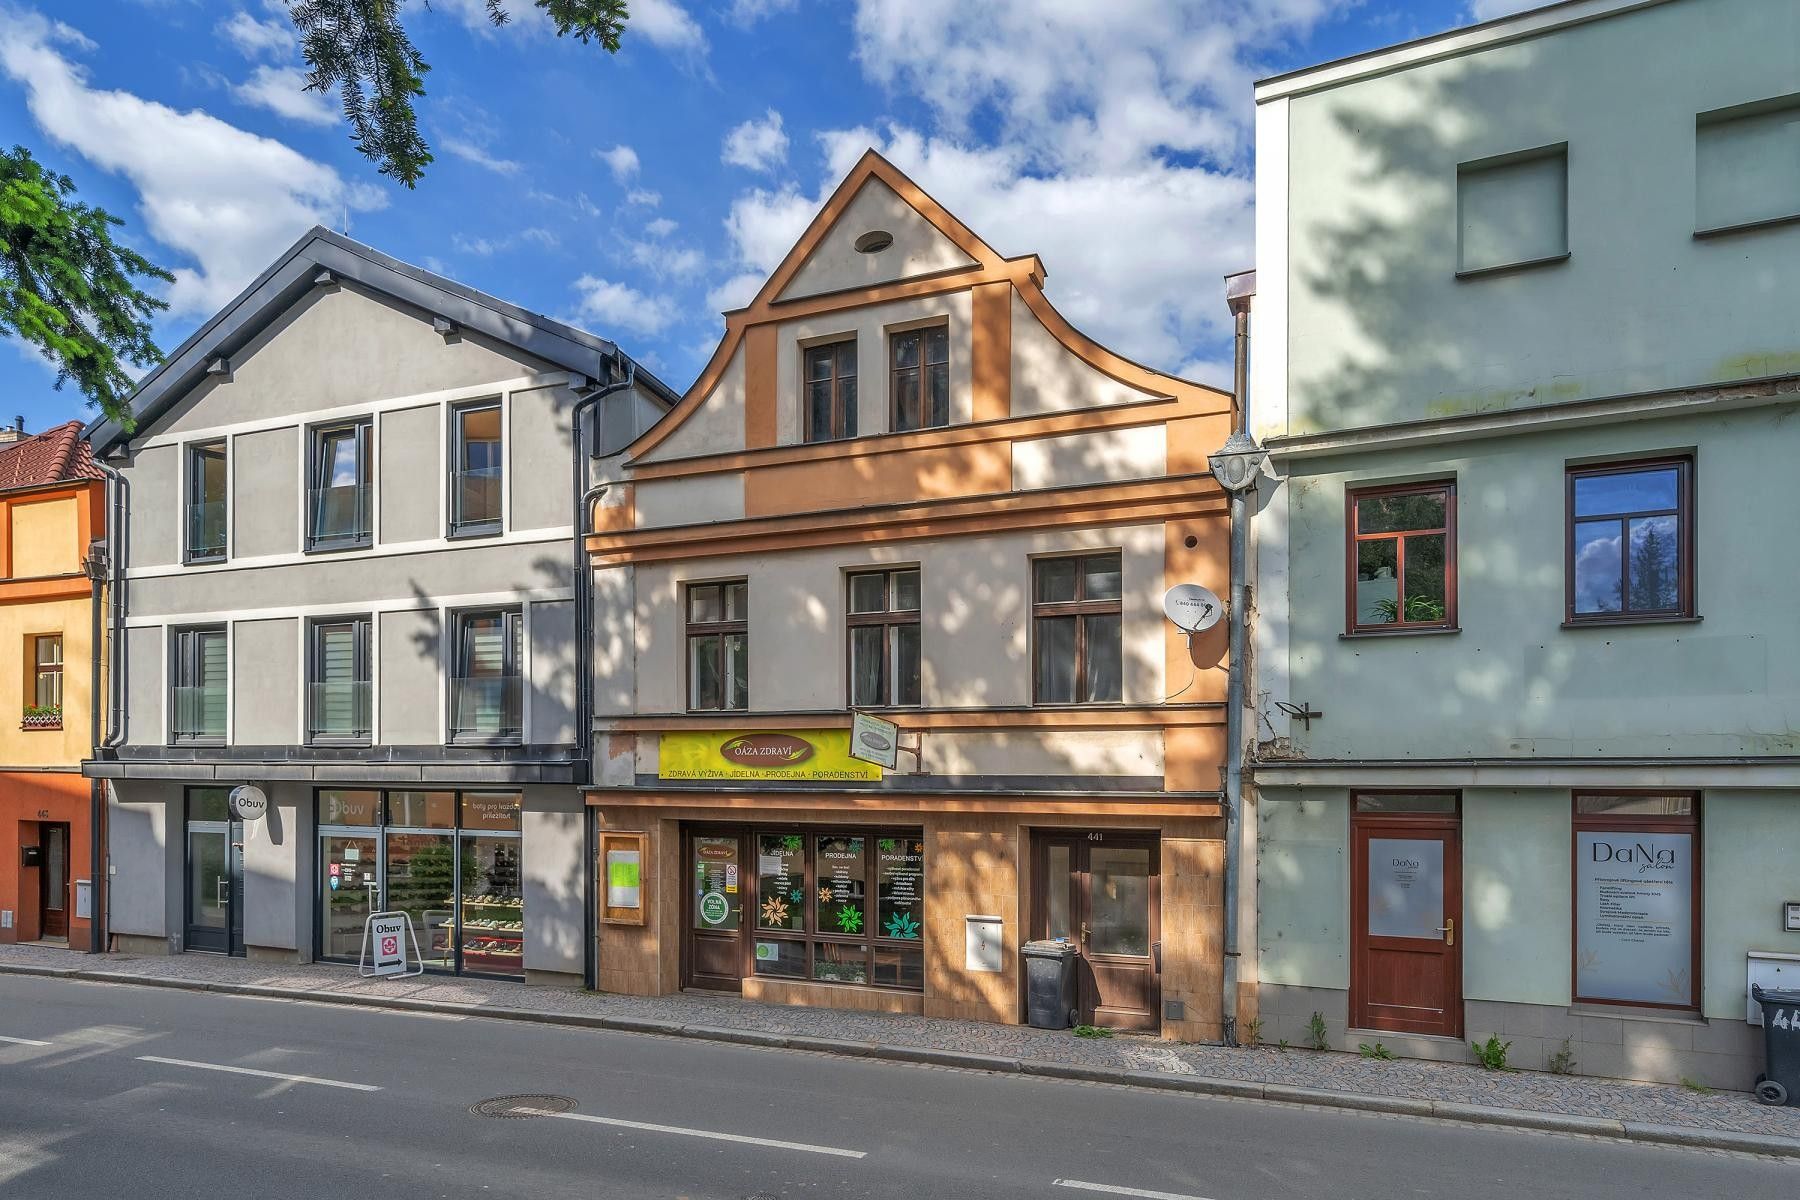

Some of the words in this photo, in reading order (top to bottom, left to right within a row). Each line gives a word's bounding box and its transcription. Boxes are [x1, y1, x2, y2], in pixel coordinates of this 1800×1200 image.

[735, 746, 758, 756] OÁZA
[759, 746, 792, 756] ZDRAVÍ
[668, 769, 697, 778] ZDRAVÁ
[698, 769, 724, 778] VÝŽIVA
[730, 769, 760, 778] JÍDELNA
[766, 770, 806, 779] PRODEJNA
[812, 769, 868, 779] PORADENSTVÍ
[238, 797, 265, 809] Obuv
[1087, 832, 1103, 841] 441
[1592, 842, 1675, 864] DaNa
[1392, 858, 1419, 867] DaNa
[1638, 857, 1675, 873] salon
[376, 924, 401, 934] Obuv
